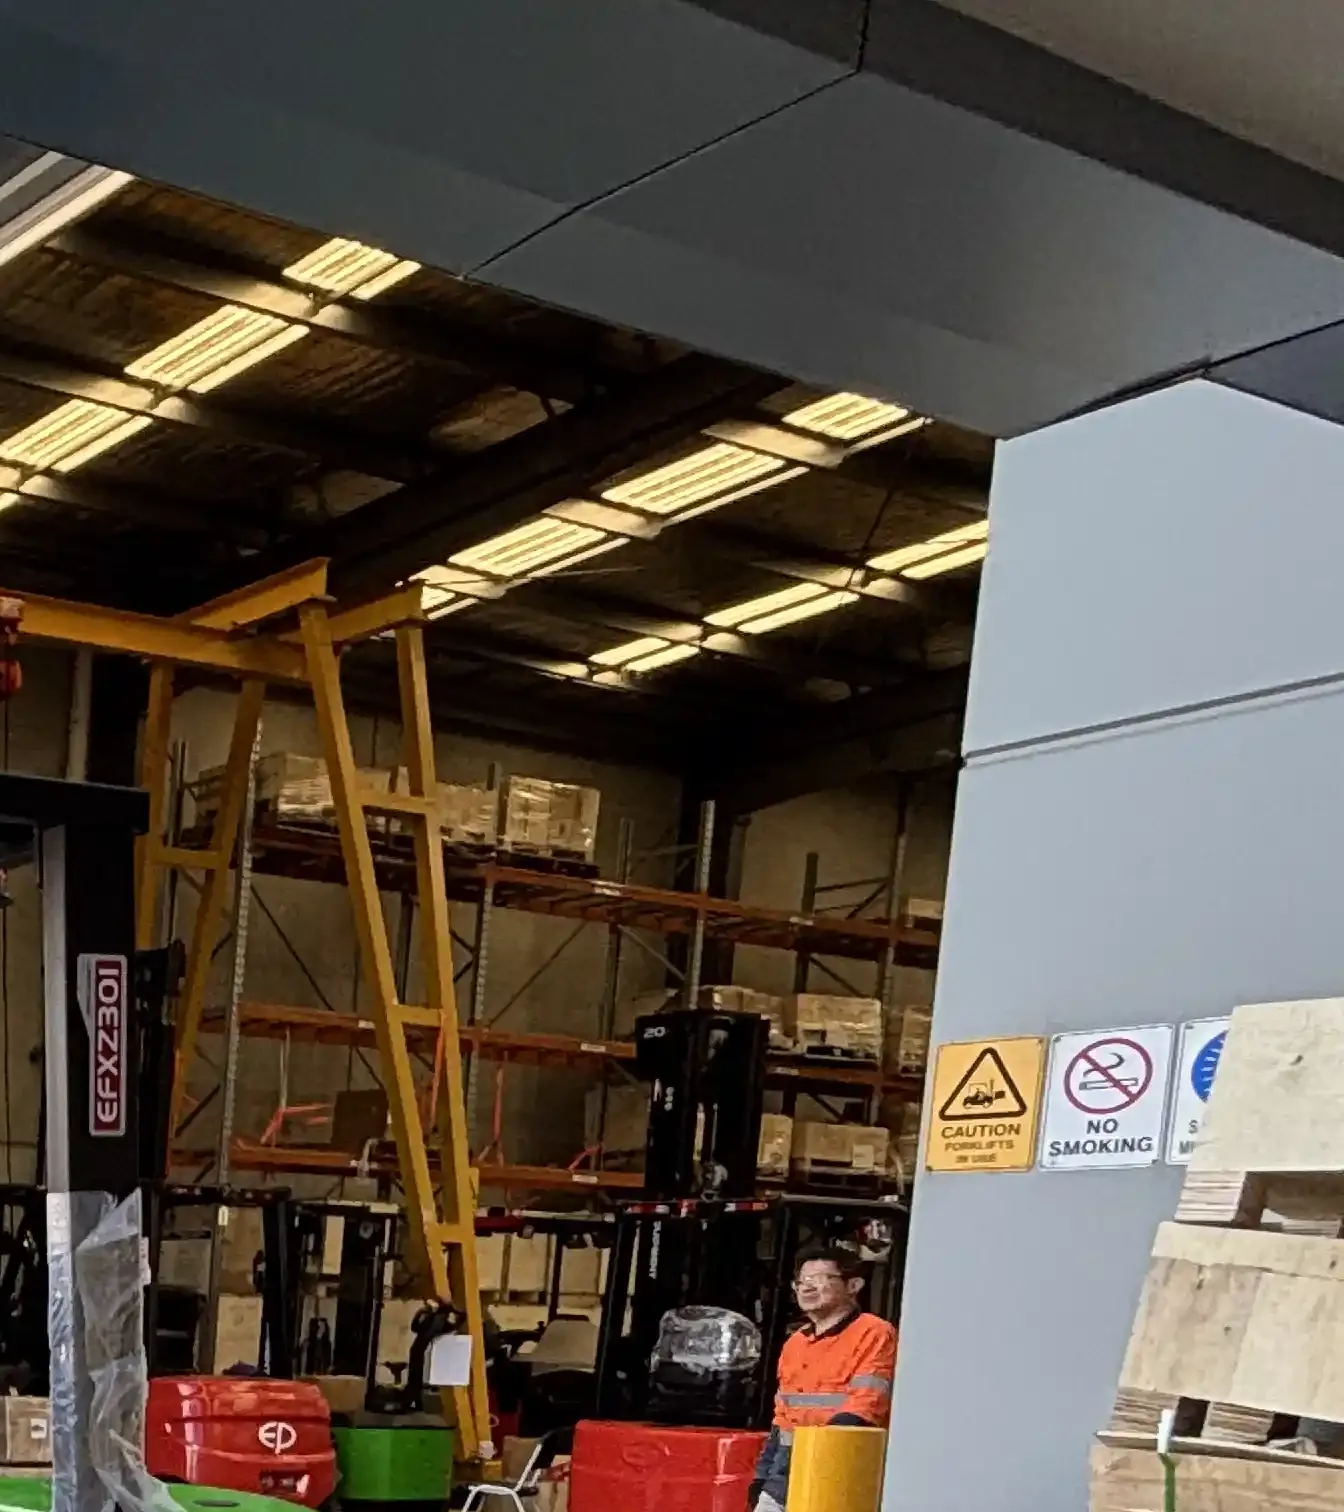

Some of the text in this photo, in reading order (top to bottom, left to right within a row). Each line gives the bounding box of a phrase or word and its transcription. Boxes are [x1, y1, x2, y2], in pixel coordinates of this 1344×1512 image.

[941, 1123, 1021, 1139] CAUTION
[1086, 1118, 1118, 1134] NO
[1048, 1136, 1153, 1157] SMOKING
[258, 1421, 297, 1455] EP
